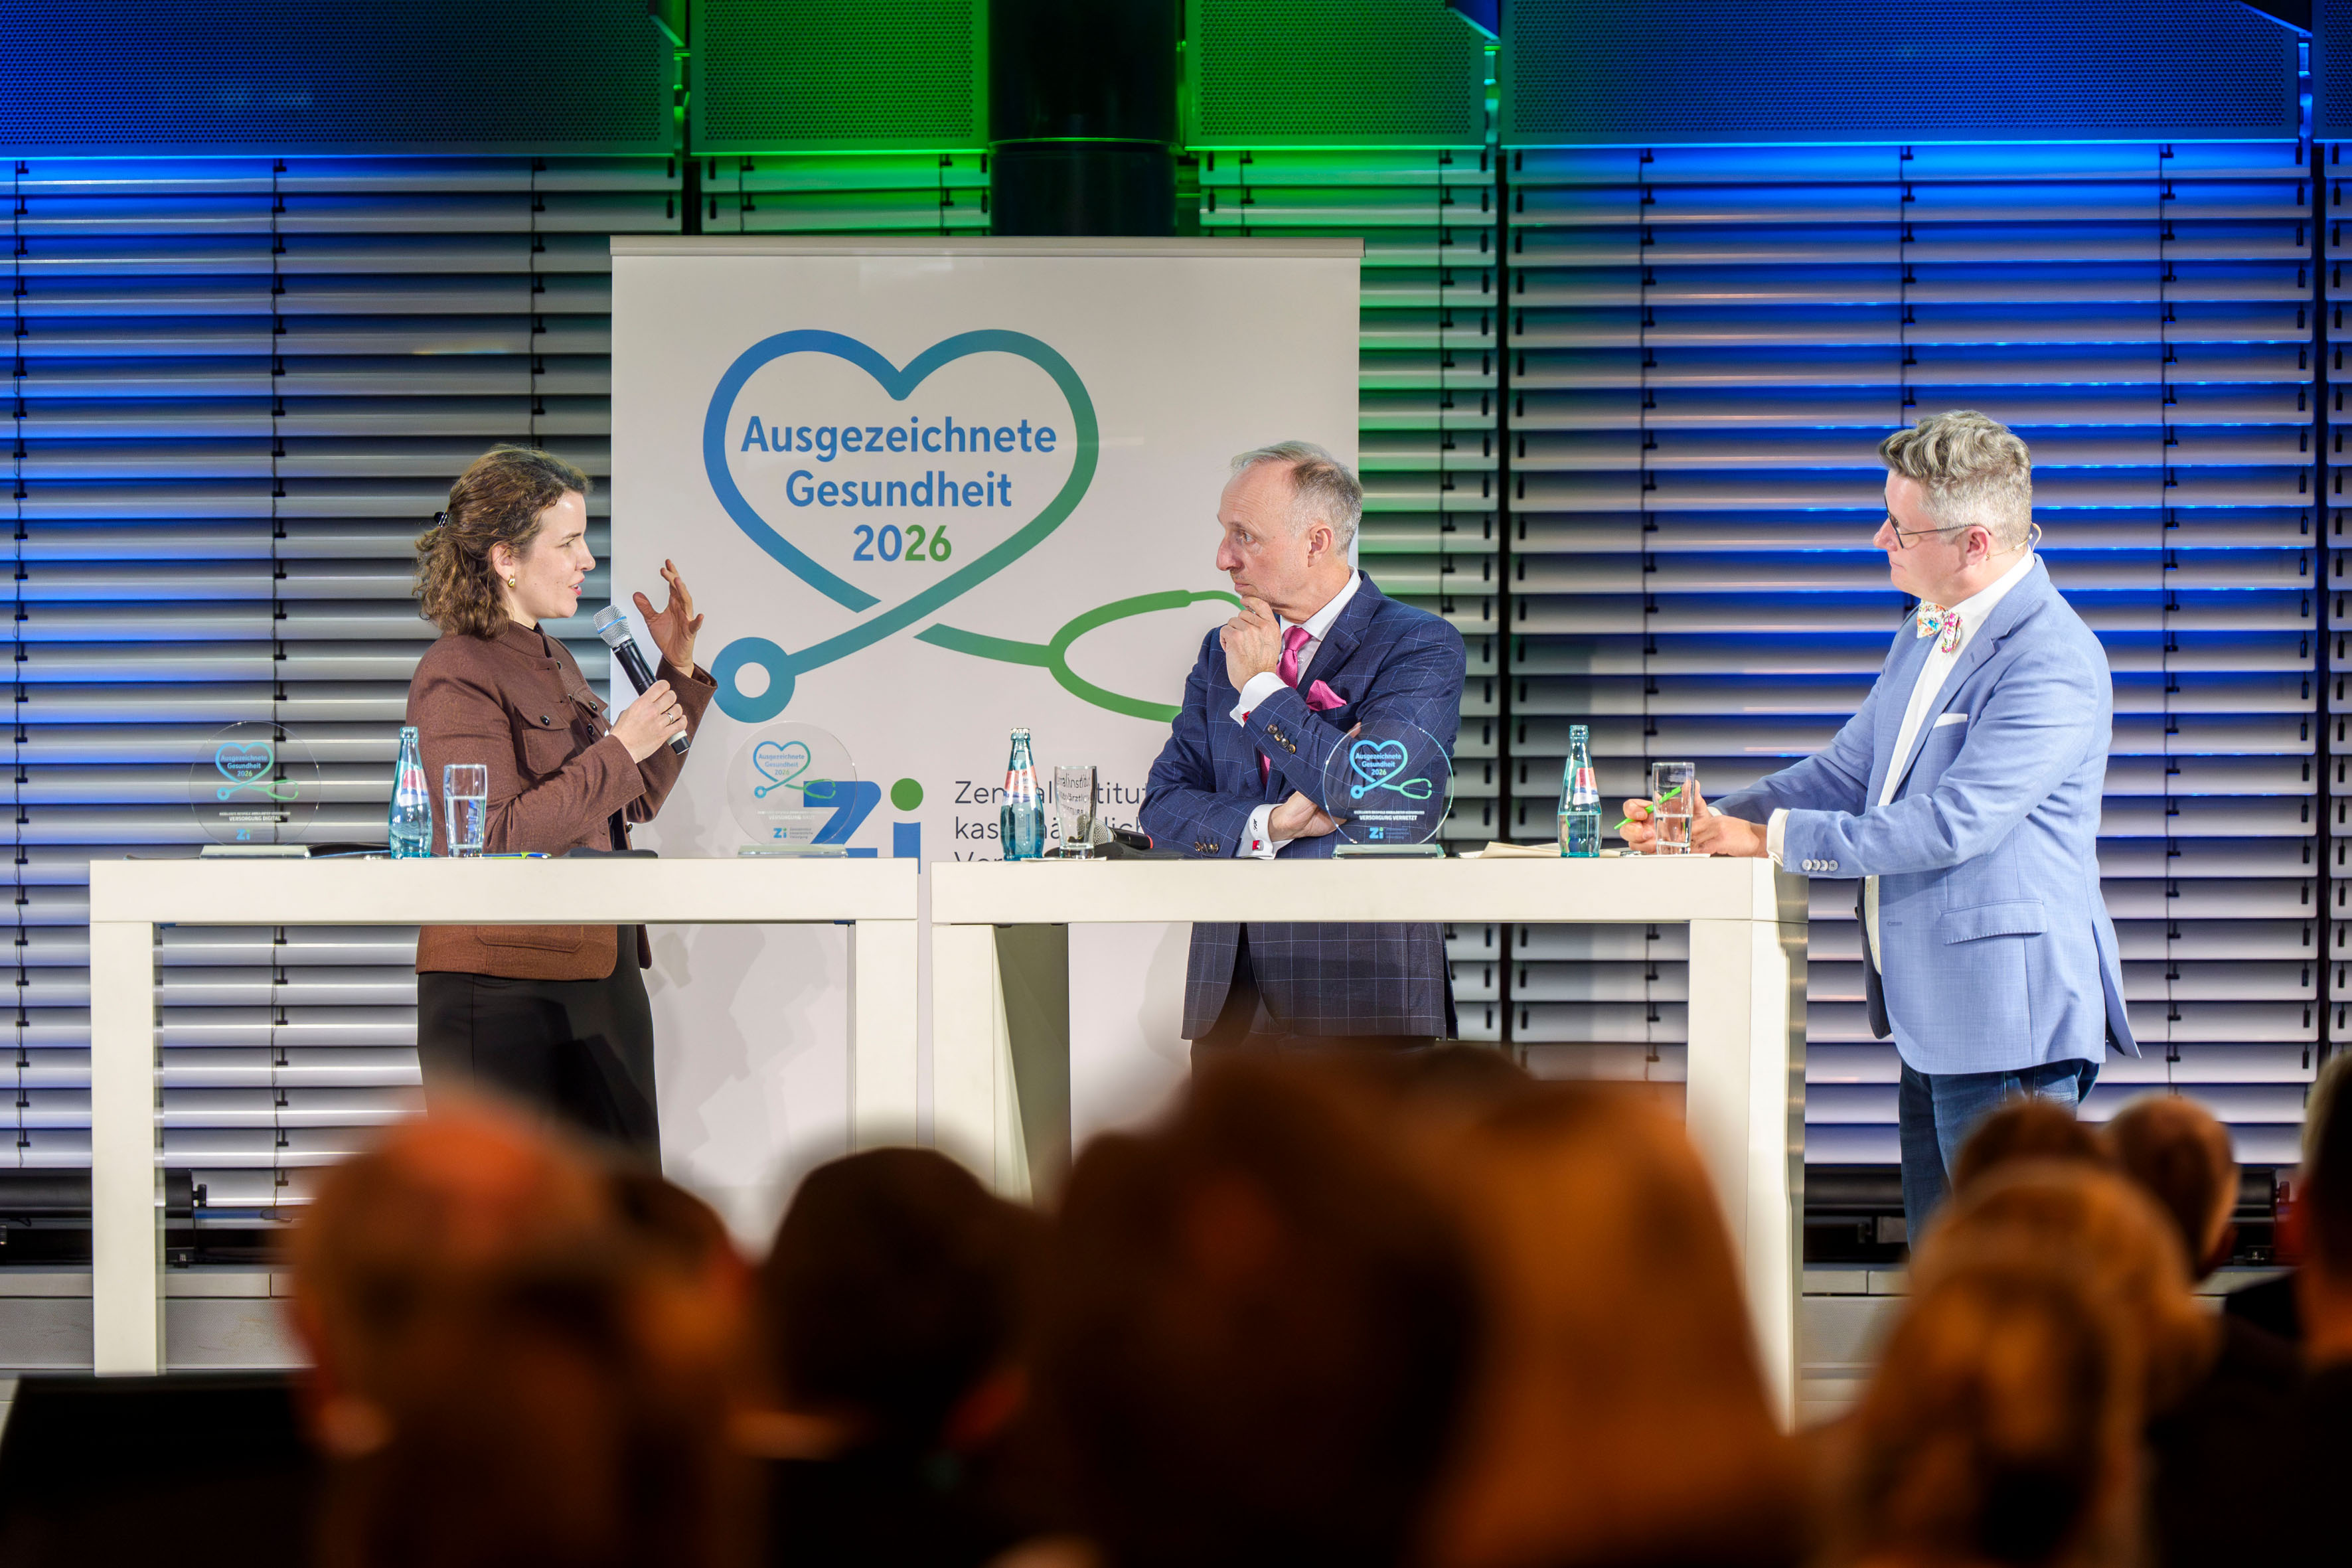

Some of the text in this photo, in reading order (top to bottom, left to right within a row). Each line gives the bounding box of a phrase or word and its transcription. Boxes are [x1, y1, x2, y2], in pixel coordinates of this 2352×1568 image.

[741, 416, 1057, 463] Ausgezeichnete
[785, 470, 1012, 508] Gesundheit
[852, 524, 953, 562] 2026
[221, 754, 268, 763] Ausgezeichnete
[803, 777, 924, 858] Zi
[236, 828, 250, 840] Zi
[773, 827, 787, 838] Zi
[1368, 826, 1384, 839] Zi
